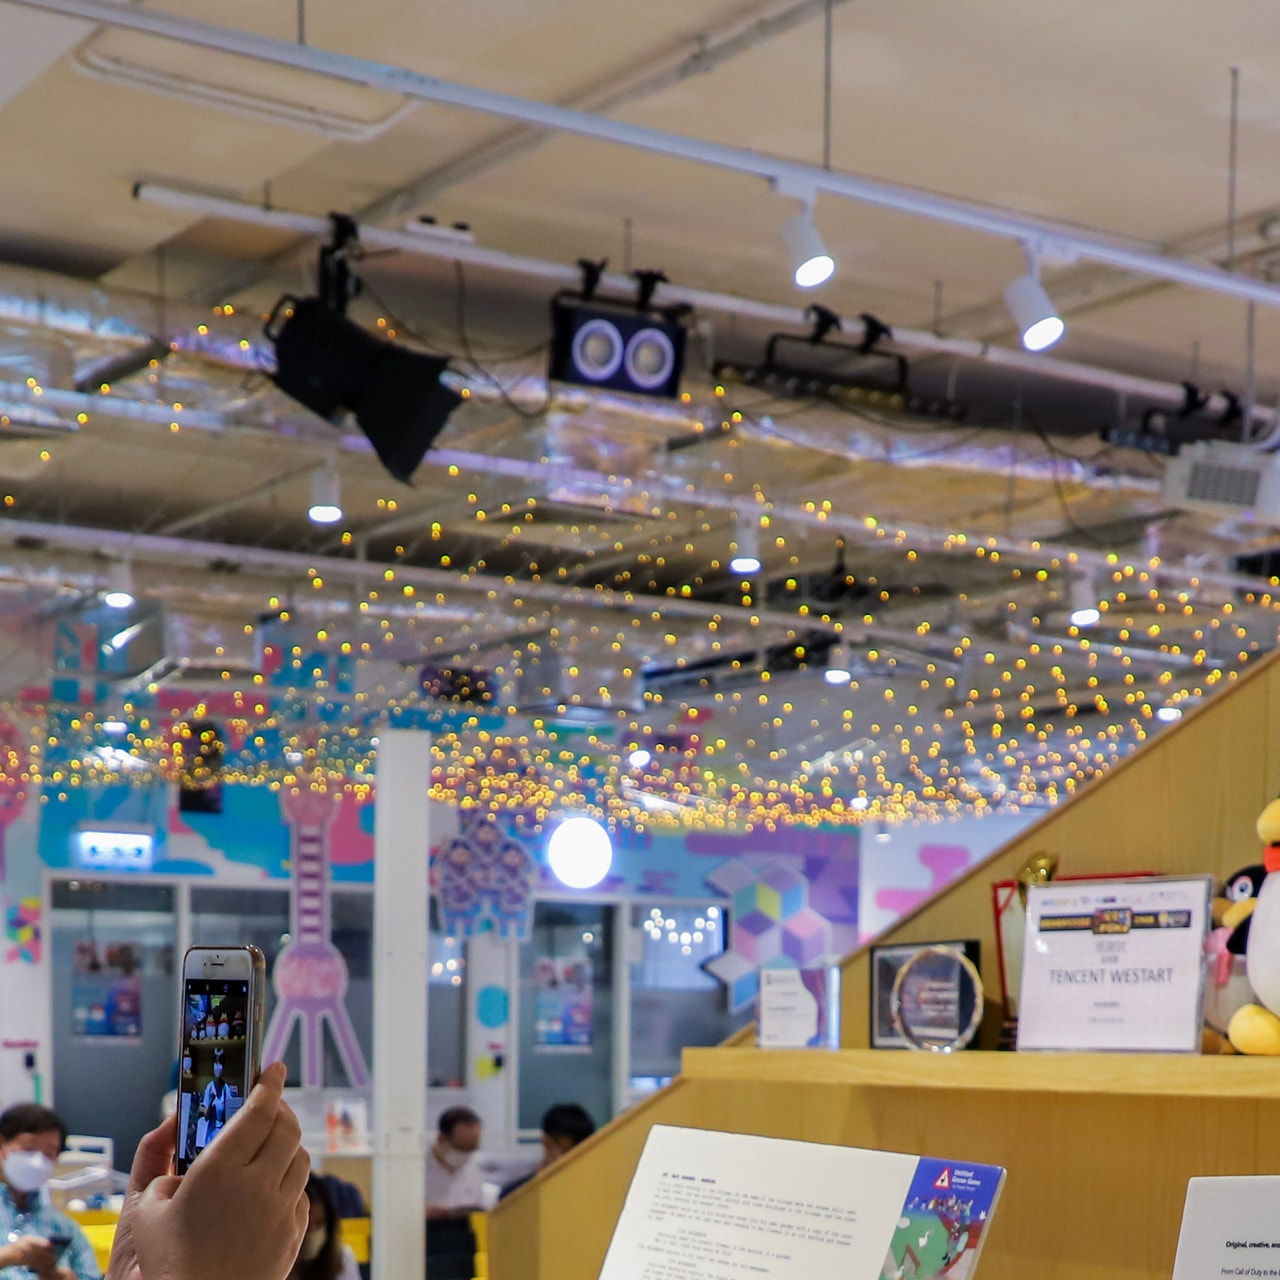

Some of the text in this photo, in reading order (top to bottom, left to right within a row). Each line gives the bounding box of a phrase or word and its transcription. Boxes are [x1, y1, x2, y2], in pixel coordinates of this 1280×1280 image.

[1050, 967, 1174, 984] TENCENT WESTART
[1220, 1267, 1234, 1275] From
[1234, 1267, 1244, 1275] Call
[1250, 1268, 1262, 1277] Duty
